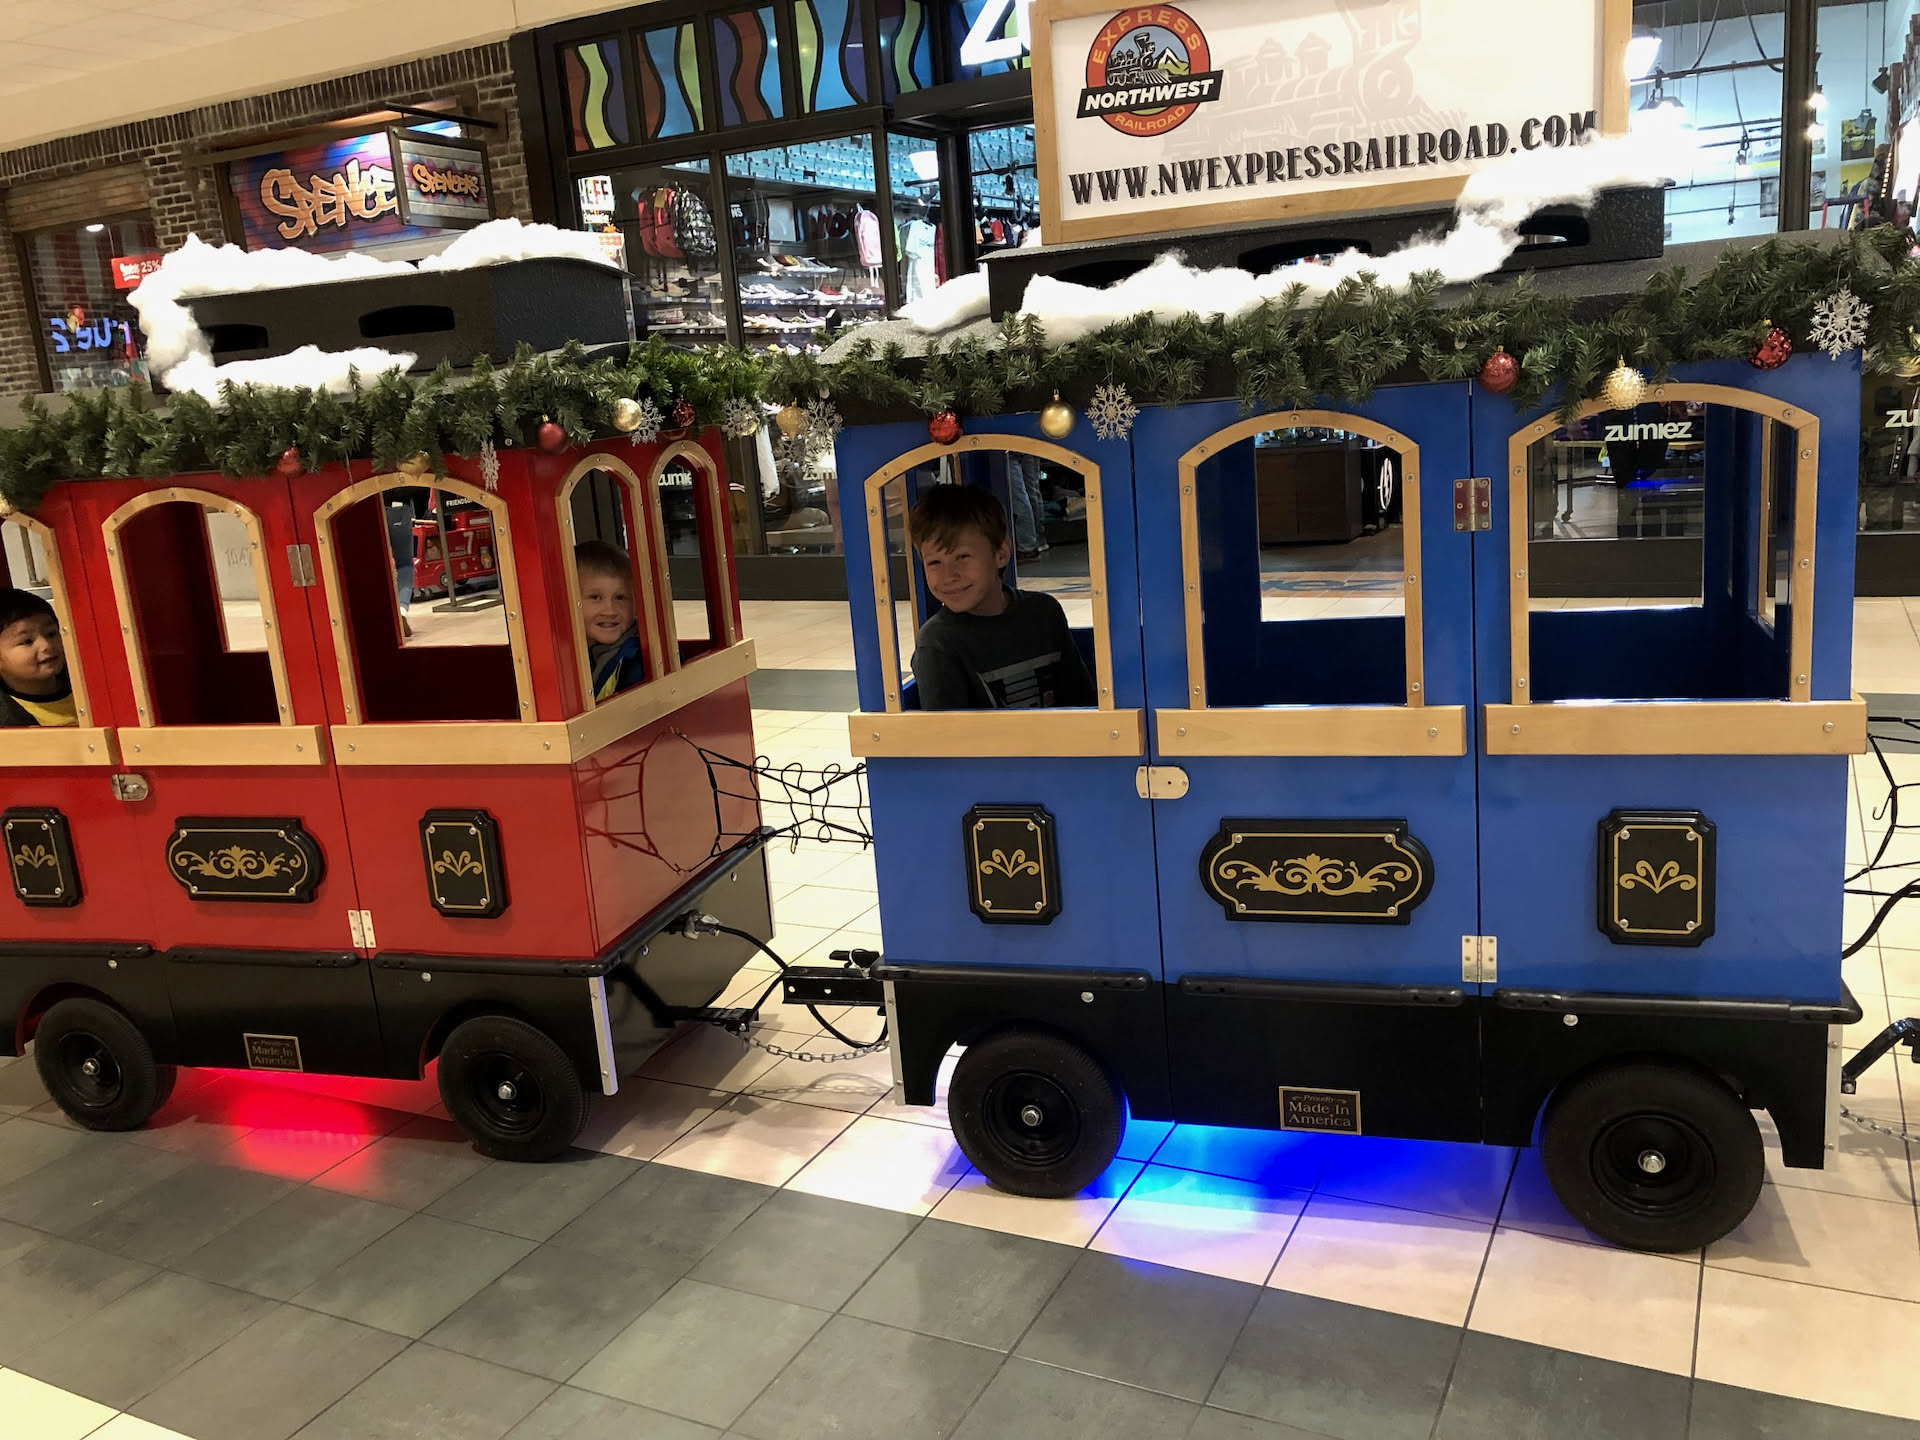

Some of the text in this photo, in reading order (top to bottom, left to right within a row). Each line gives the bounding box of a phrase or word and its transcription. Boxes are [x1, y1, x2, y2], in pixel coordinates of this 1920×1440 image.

[1093, 9, 1201, 65] EXPRESS
[1085, 78, 1215, 111] NORTHWEST
[1115, 106, 1186, 131] RAILROAD
[1068, 109, 1597, 206] WWW.NWEXPRESSRAILROAD.COM
[261, 158, 399, 239] SPENCE
[1605, 421, 1693, 441] zumiez
[1288, 1114, 1351, 1126] America
[1289, 1101, 1349, 1115] Made In
